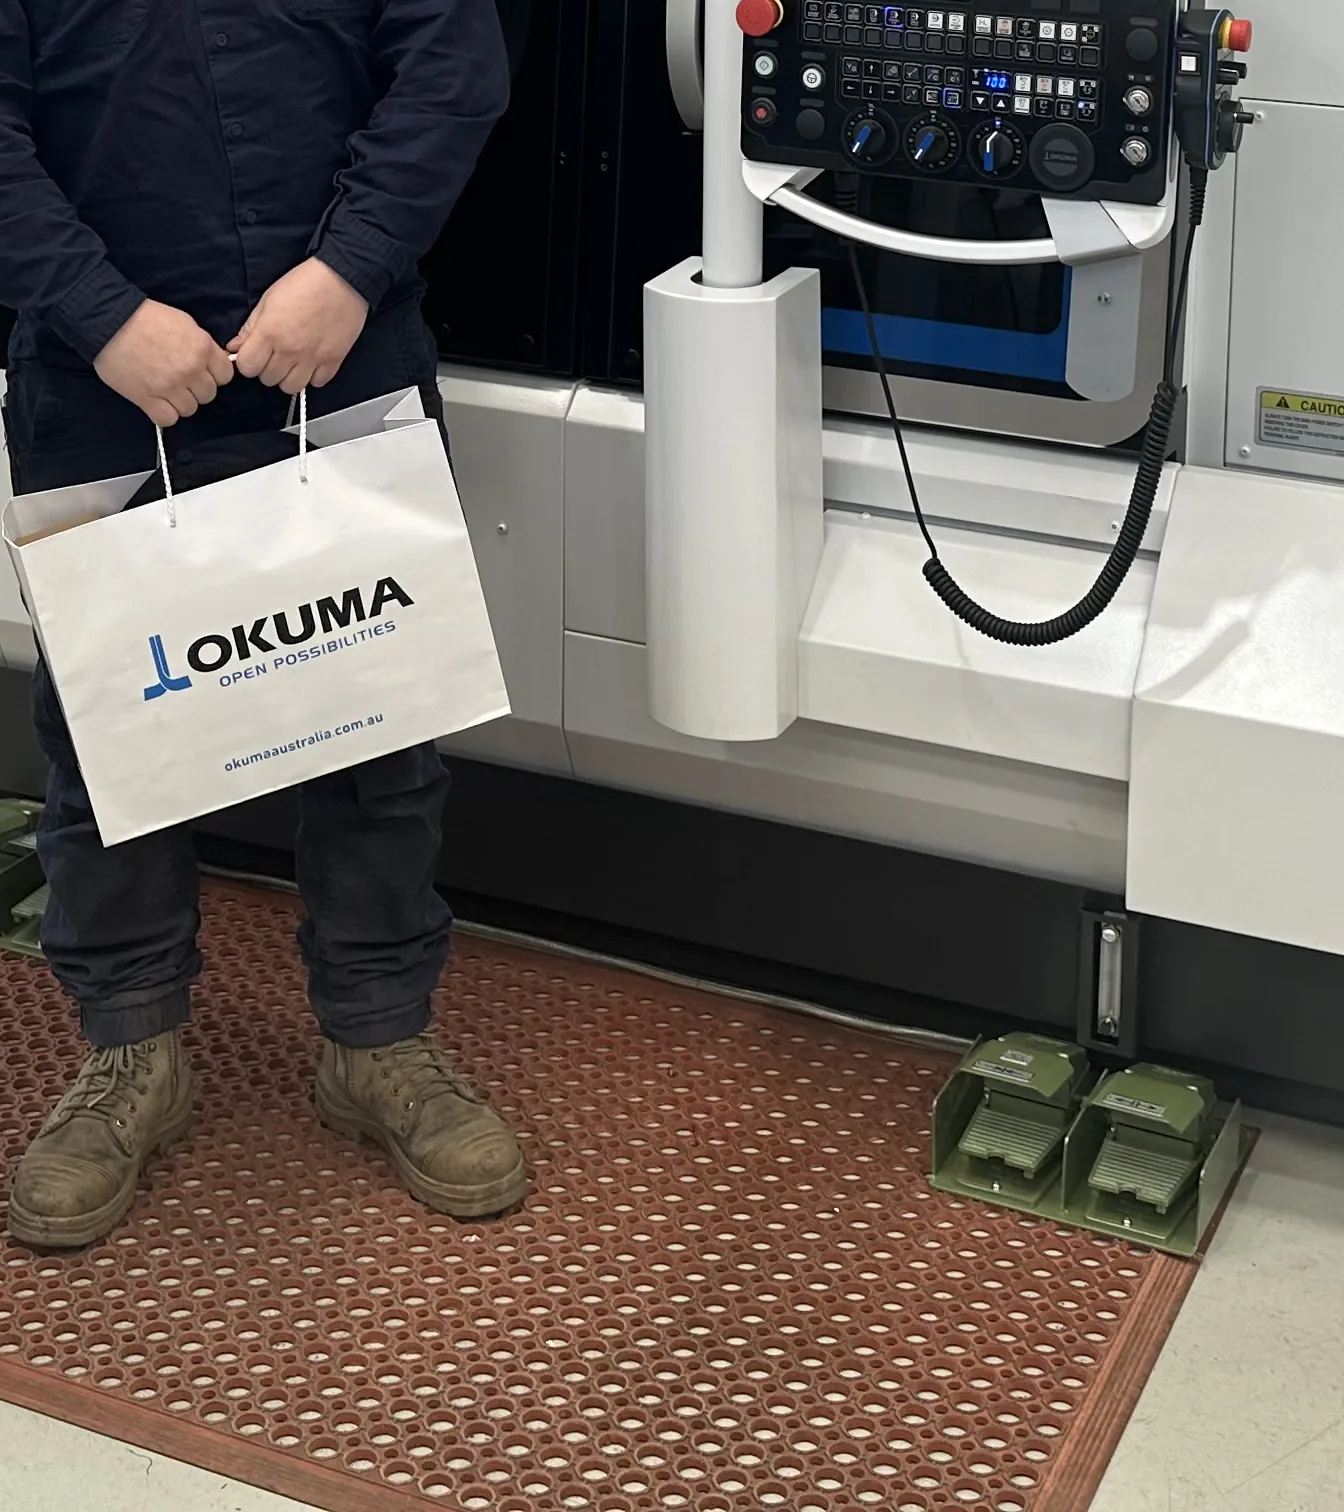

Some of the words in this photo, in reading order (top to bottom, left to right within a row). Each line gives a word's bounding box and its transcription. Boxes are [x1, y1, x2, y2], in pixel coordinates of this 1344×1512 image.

[985, 75, 1007, 89] 100
[187, 576, 415, 673] OKUMA
[219, 662, 268, 688] OPEN
[274, 620, 397, 670] POSSIBILITIES
[224, 713, 384, 772] okumaaustralia.com.au
